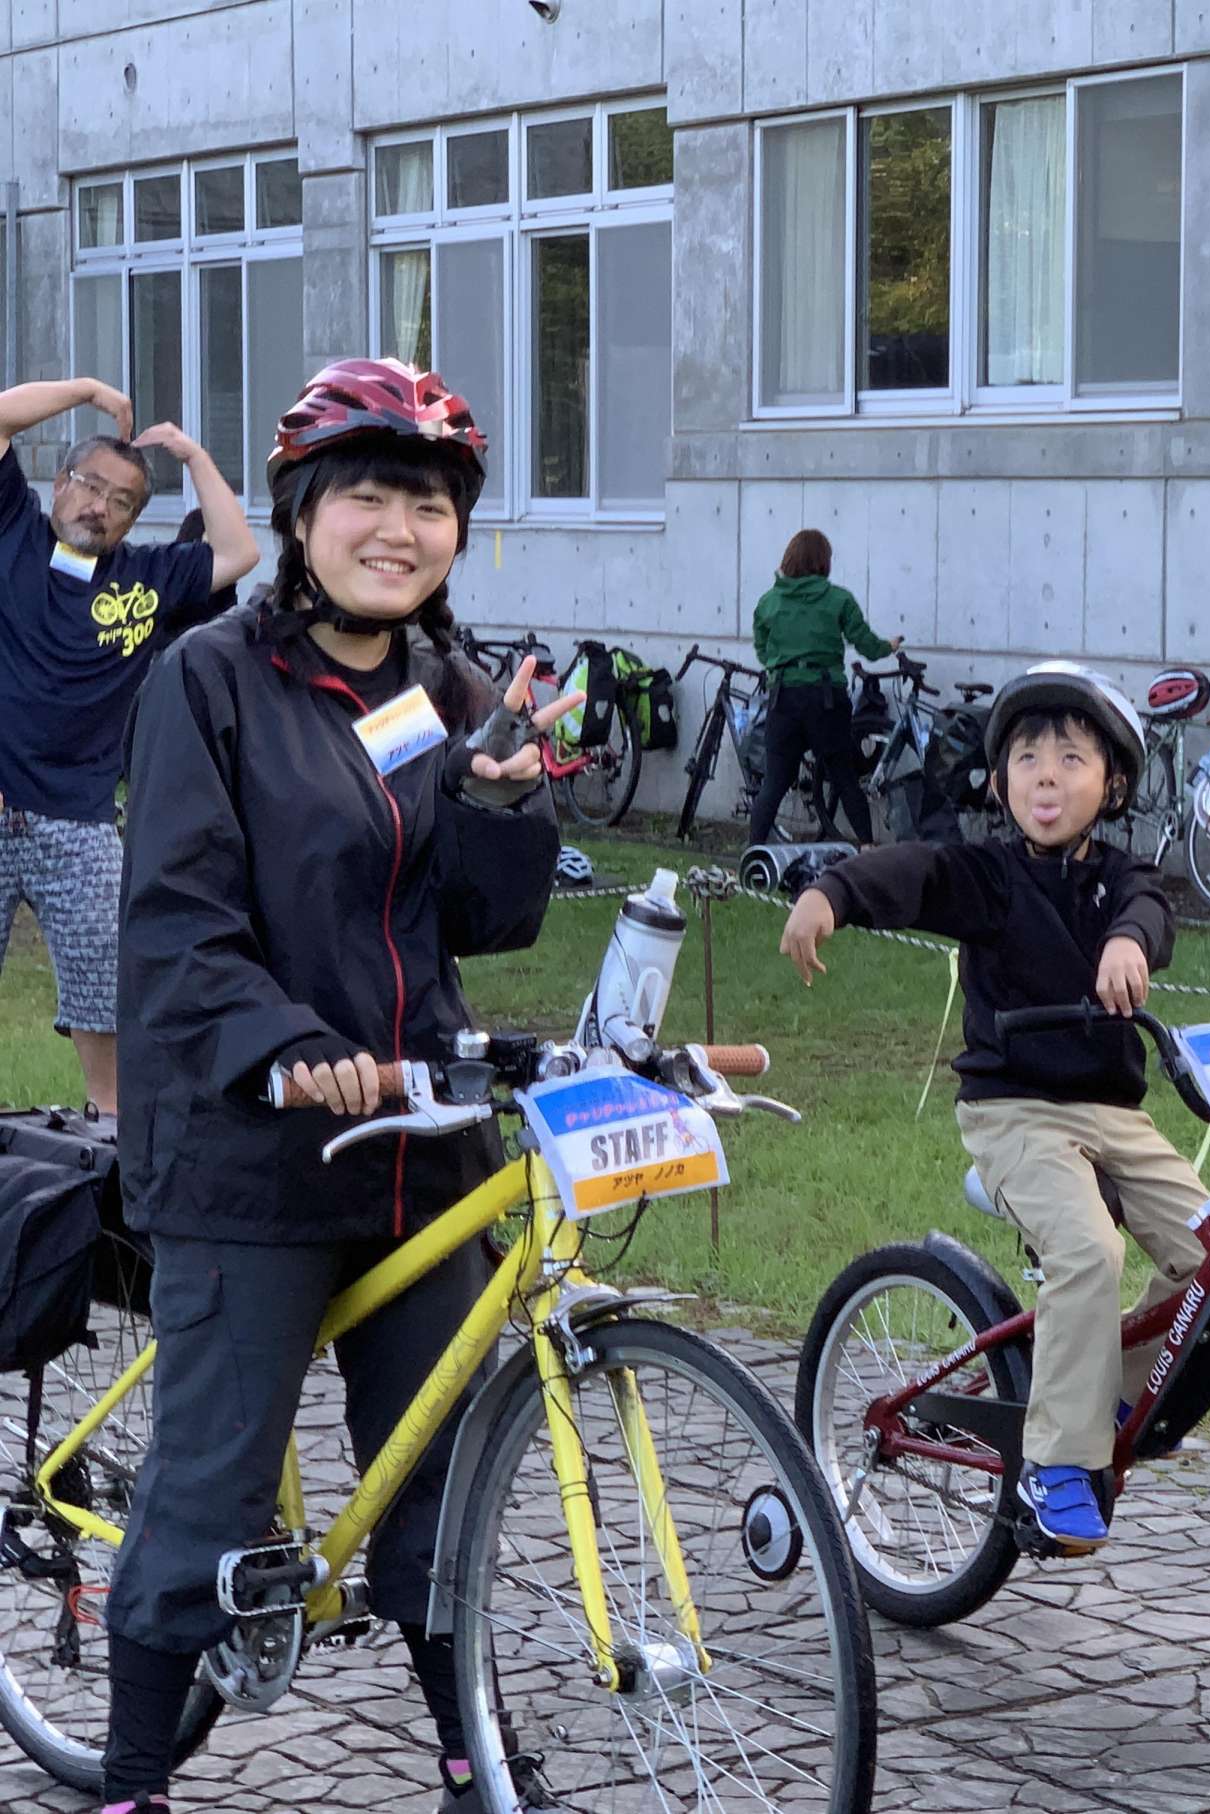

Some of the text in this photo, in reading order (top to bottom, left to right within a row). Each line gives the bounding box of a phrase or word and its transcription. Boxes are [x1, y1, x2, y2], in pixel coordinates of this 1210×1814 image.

[121, 617, 155, 658] 300
[590, 1121, 670, 1172] STAFF
[1146, 1345, 1175, 1396] LOUIS
